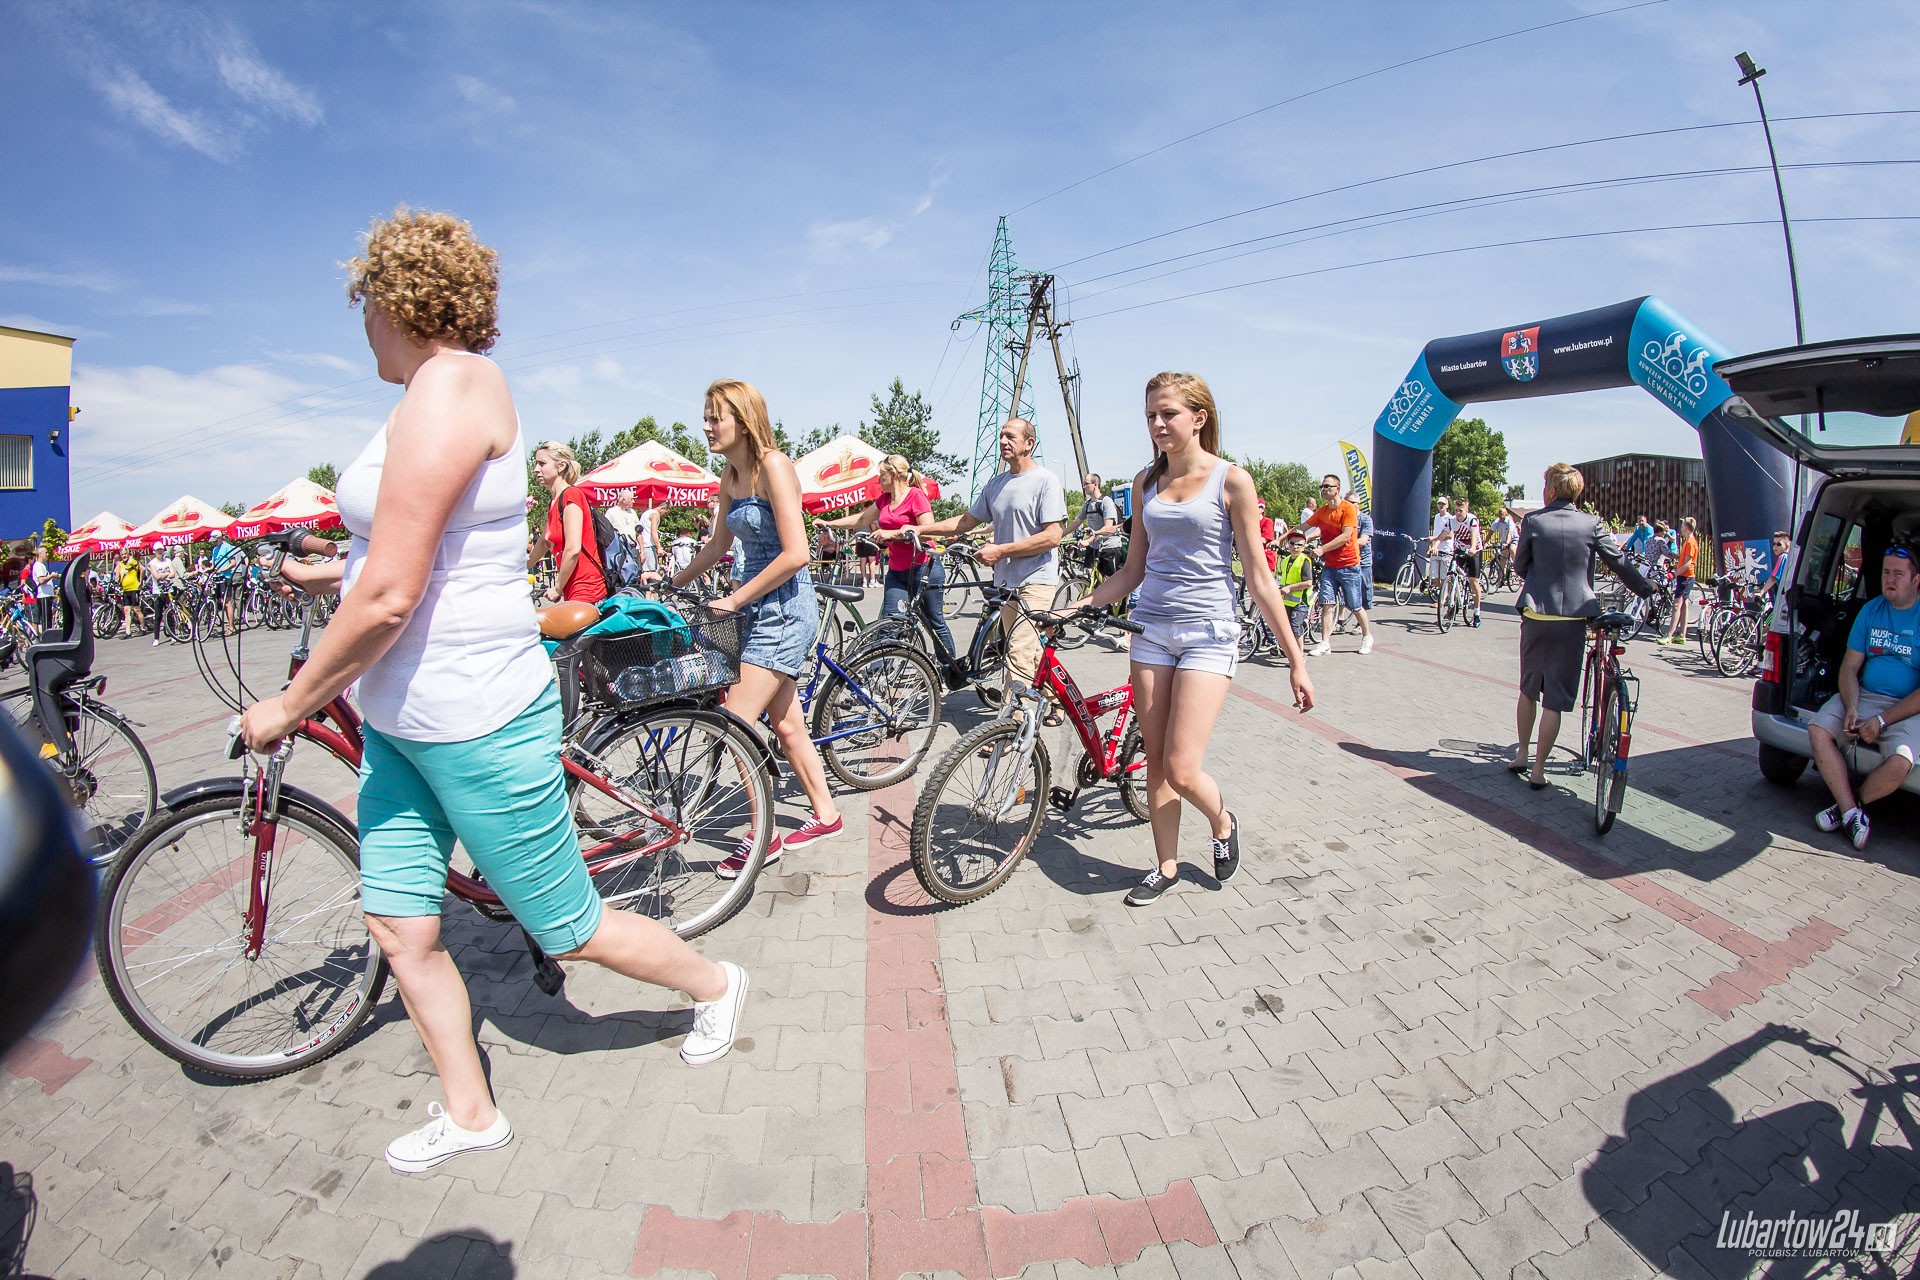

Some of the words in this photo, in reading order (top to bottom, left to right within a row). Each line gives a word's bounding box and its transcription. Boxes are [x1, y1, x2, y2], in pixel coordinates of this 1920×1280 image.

[1553, 336, 1613, 355] www.lubartow.pl
[1440, 364, 1460, 373] Miasto
[1460, 359, 1488, 371] Lubartów
[1647, 376, 1683, 409] LEWARTA
[1409, 404, 1435, 433] LEWARTA
[666, 485, 710, 501] TYSKIE
[820, 486, 867, 510] TYSKIE
[235, 524, 261, 538] TYSKIE
[160, 532, 195, 546] TYSKIE
[1870, 637, 1882, 647] THE
[1871, 629, 1892, 640] MUSIC
